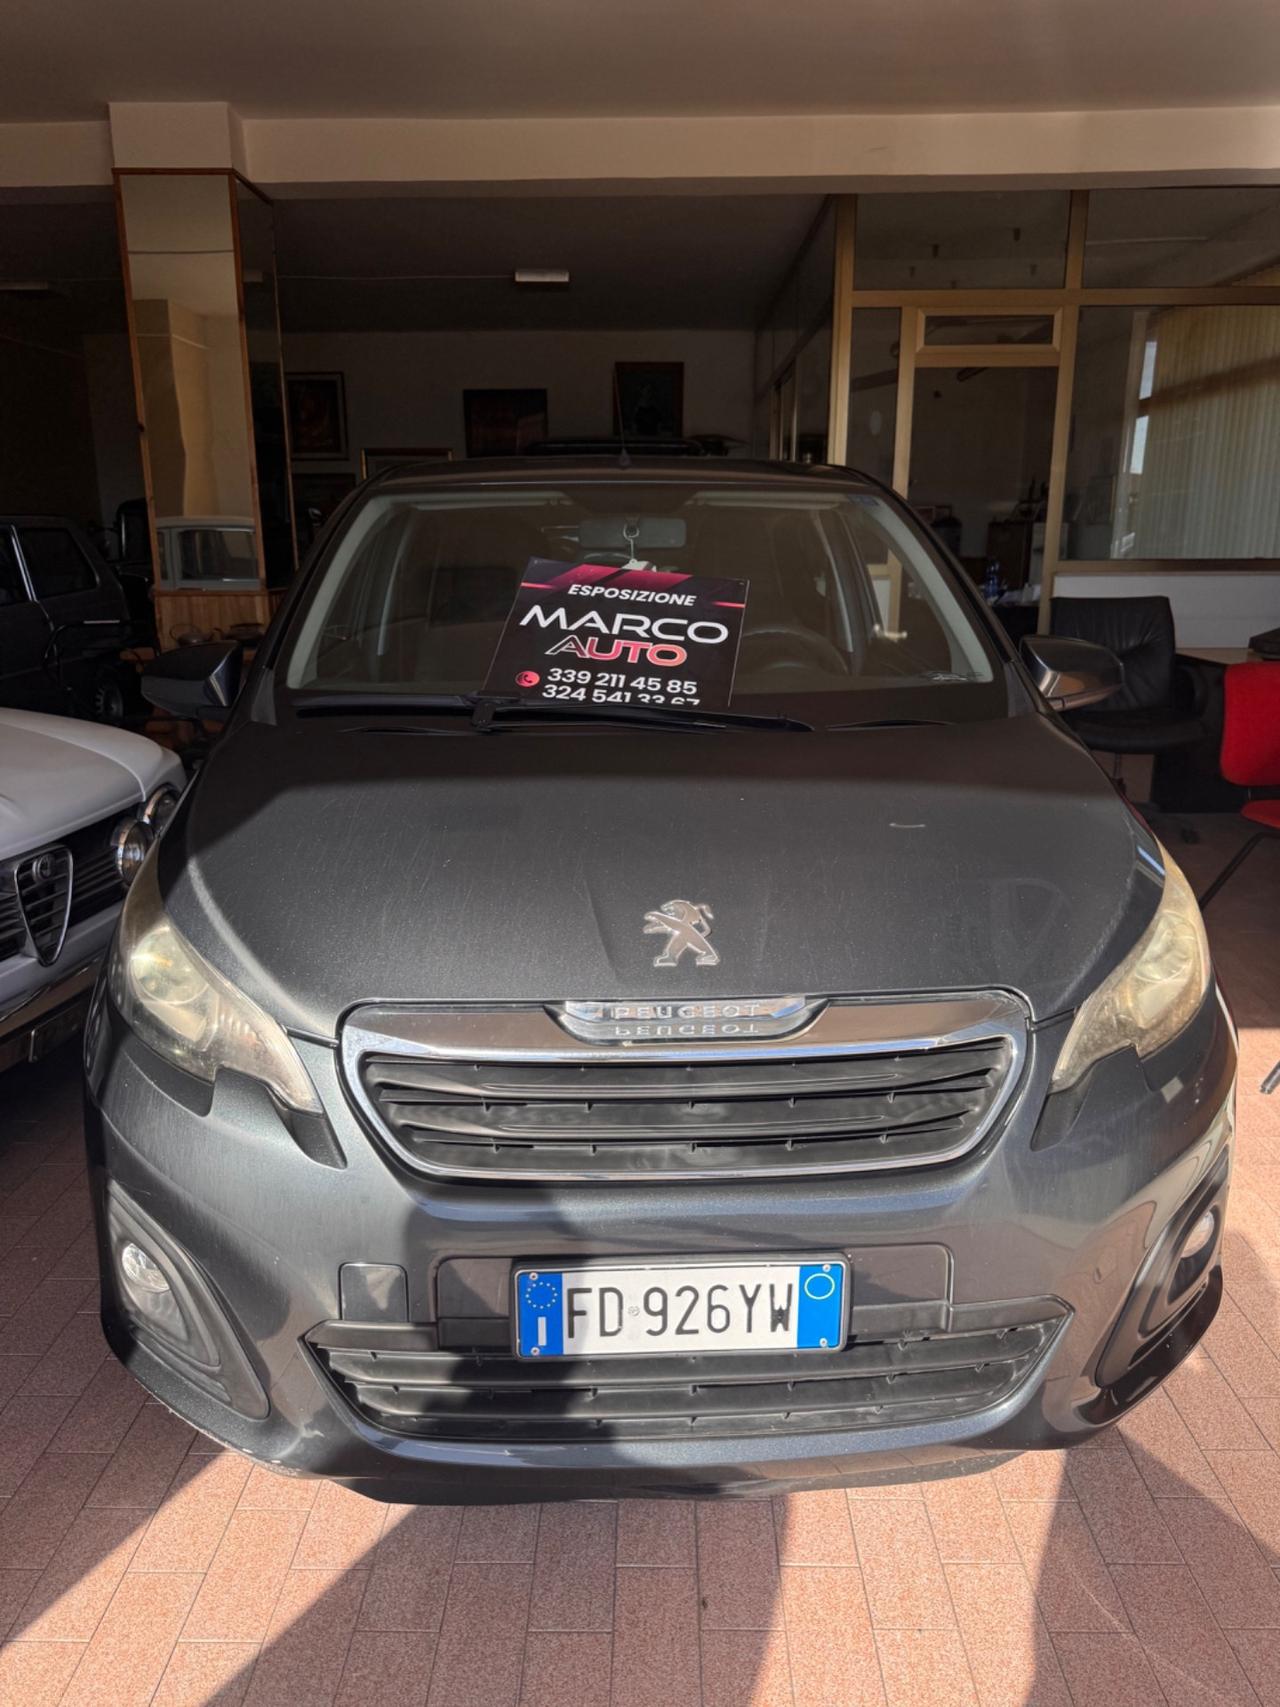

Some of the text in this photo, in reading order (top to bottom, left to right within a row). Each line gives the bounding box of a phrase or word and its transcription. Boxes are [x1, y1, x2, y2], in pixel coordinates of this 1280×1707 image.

[567, 584, 697, 606] ESPOSIZIONE
[519, 604, 729, 644] MARCO
[544, 634, 687, 667] AUTO
[542, 684, 587, 701] 324
[592, 689, 632, 703] 541
[547, 668, 697, 695] 339 211 45 85
[614, 1003, 760, 1020] PEUGEOT
[567, 1283, 793, 1339] FD 926YW
